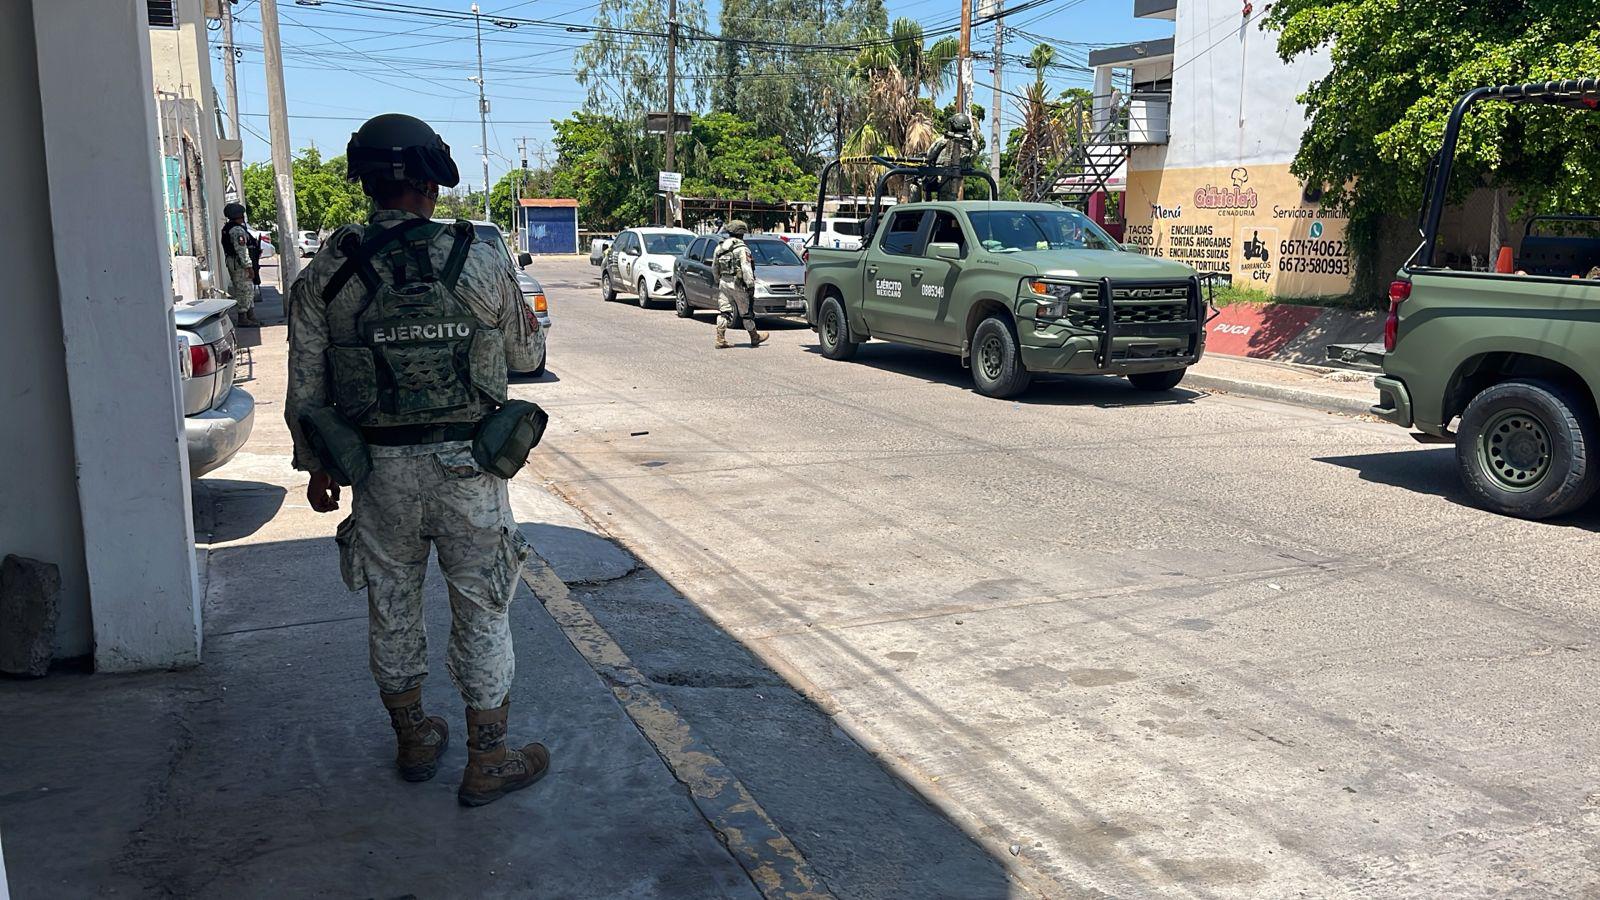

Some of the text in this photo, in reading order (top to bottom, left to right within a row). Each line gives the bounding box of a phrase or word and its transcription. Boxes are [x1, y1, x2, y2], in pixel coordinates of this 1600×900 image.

[1151, 204, 1181, 219] Menú
[1273, 205, 1307, 219] Servicio
[1308, 209, 1314, 218] a
[1128, 225, 1153, 235] TACOS
[1171, 225, 1213, 236] ENCHILADAS
[1127, 236, 1154, 246] ASADO
[1170, 236, 1232, 248] TORTAS AHOGADAS
[1169, 248, 1229, 259] ENCHILADAS SUIZAS
[1195, 261, 1230, 272] TORTILLAS
[1241, 261, 1271, 270] BARRANCOS
[1253, 269, 1271, 283] City
[876, 279, 902, 291] EJÉRCITO
[876, 289, 902, 298] MEXICANO
[1082, 288, 1188, 298] CEVROLET
[1213, 323, 1251, 336] PUGA
